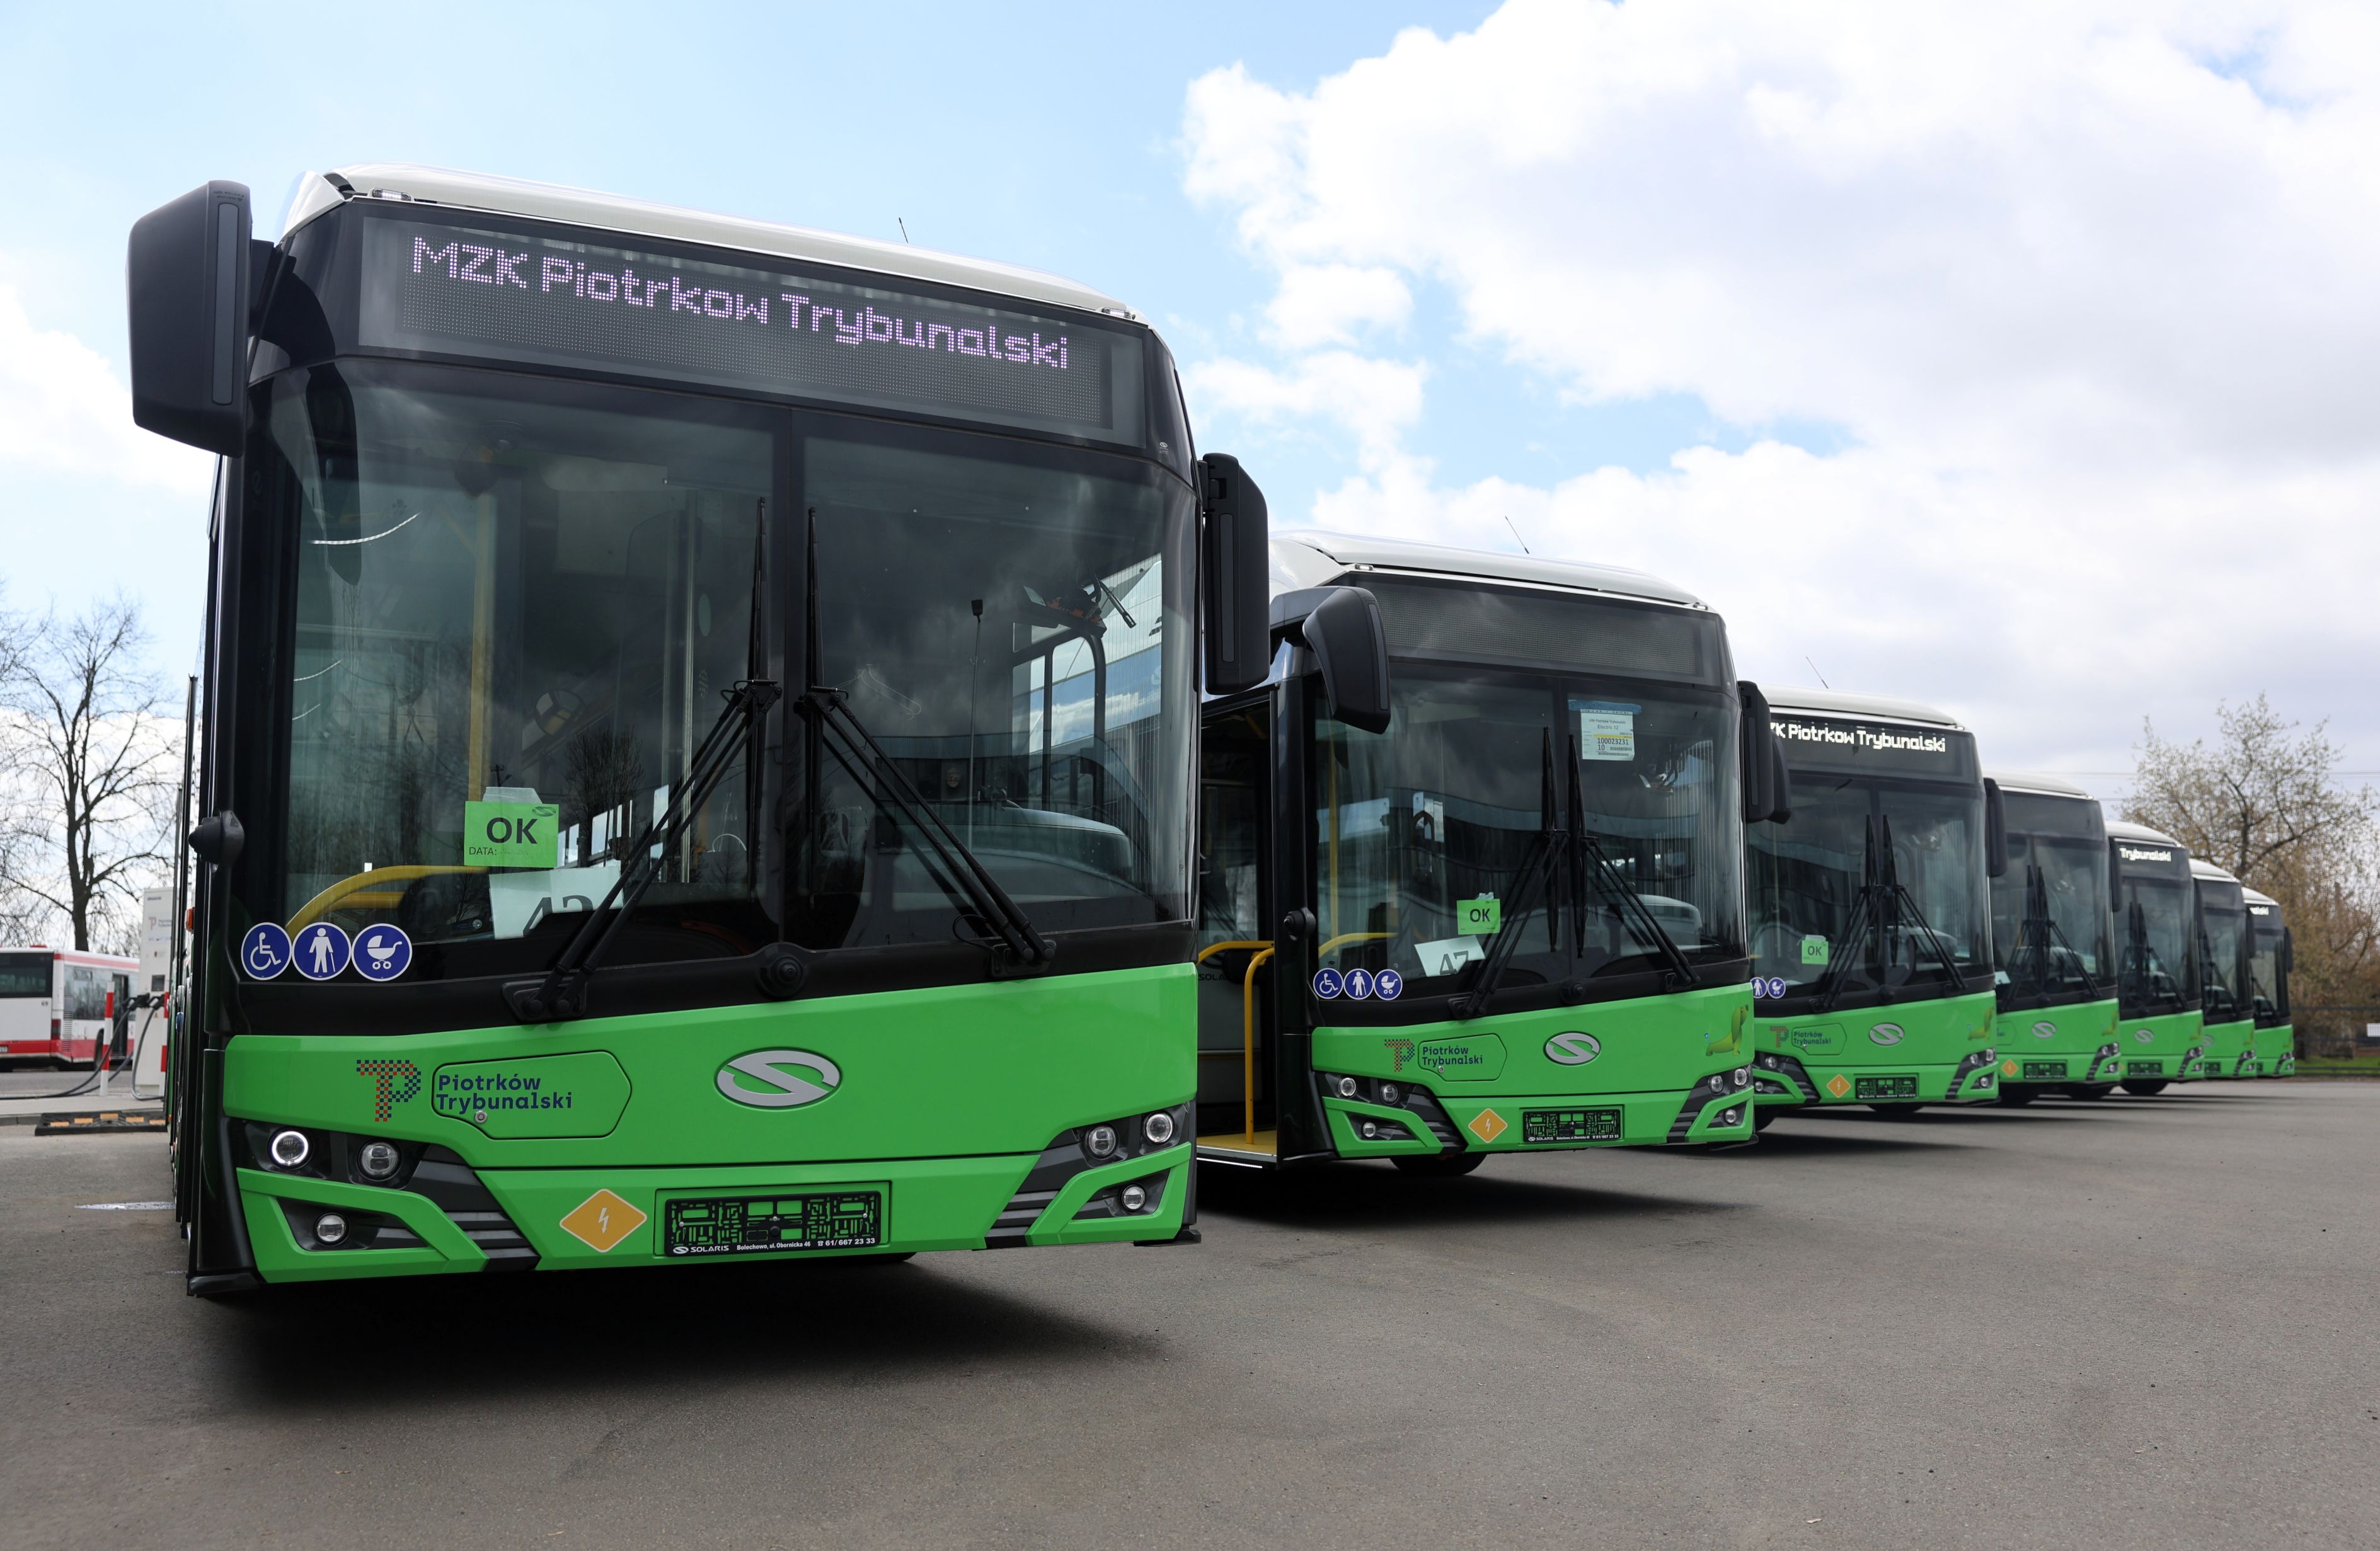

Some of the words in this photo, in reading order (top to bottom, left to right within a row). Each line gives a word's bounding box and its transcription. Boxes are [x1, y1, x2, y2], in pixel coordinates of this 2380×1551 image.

[414, 237, 527, 289] MZK
[543, 256, 767, 324] Piotrkow
[782, 294, 1067, 369] Trybunalski
[1788, 724, 1854, 745] Piotrkow
[1857, 730, 1946, 752] Trybunalski
[486, 817, 538, 845] OK
[469, 847, 497, 856] DATA:
[1469, 908, 1491, 922] OK
[1807, 946, 1822, 956] OK
[1422, 1045, 1469, 1055] Piotrków
[1422, 1055, 1483, 1068] Trybunalski
[439, 1073, 541, 1091] Piotrków
[436, 1092, 573, 1114] Trybunalski
[690, 1245, 730, 1253] SOLARIS
